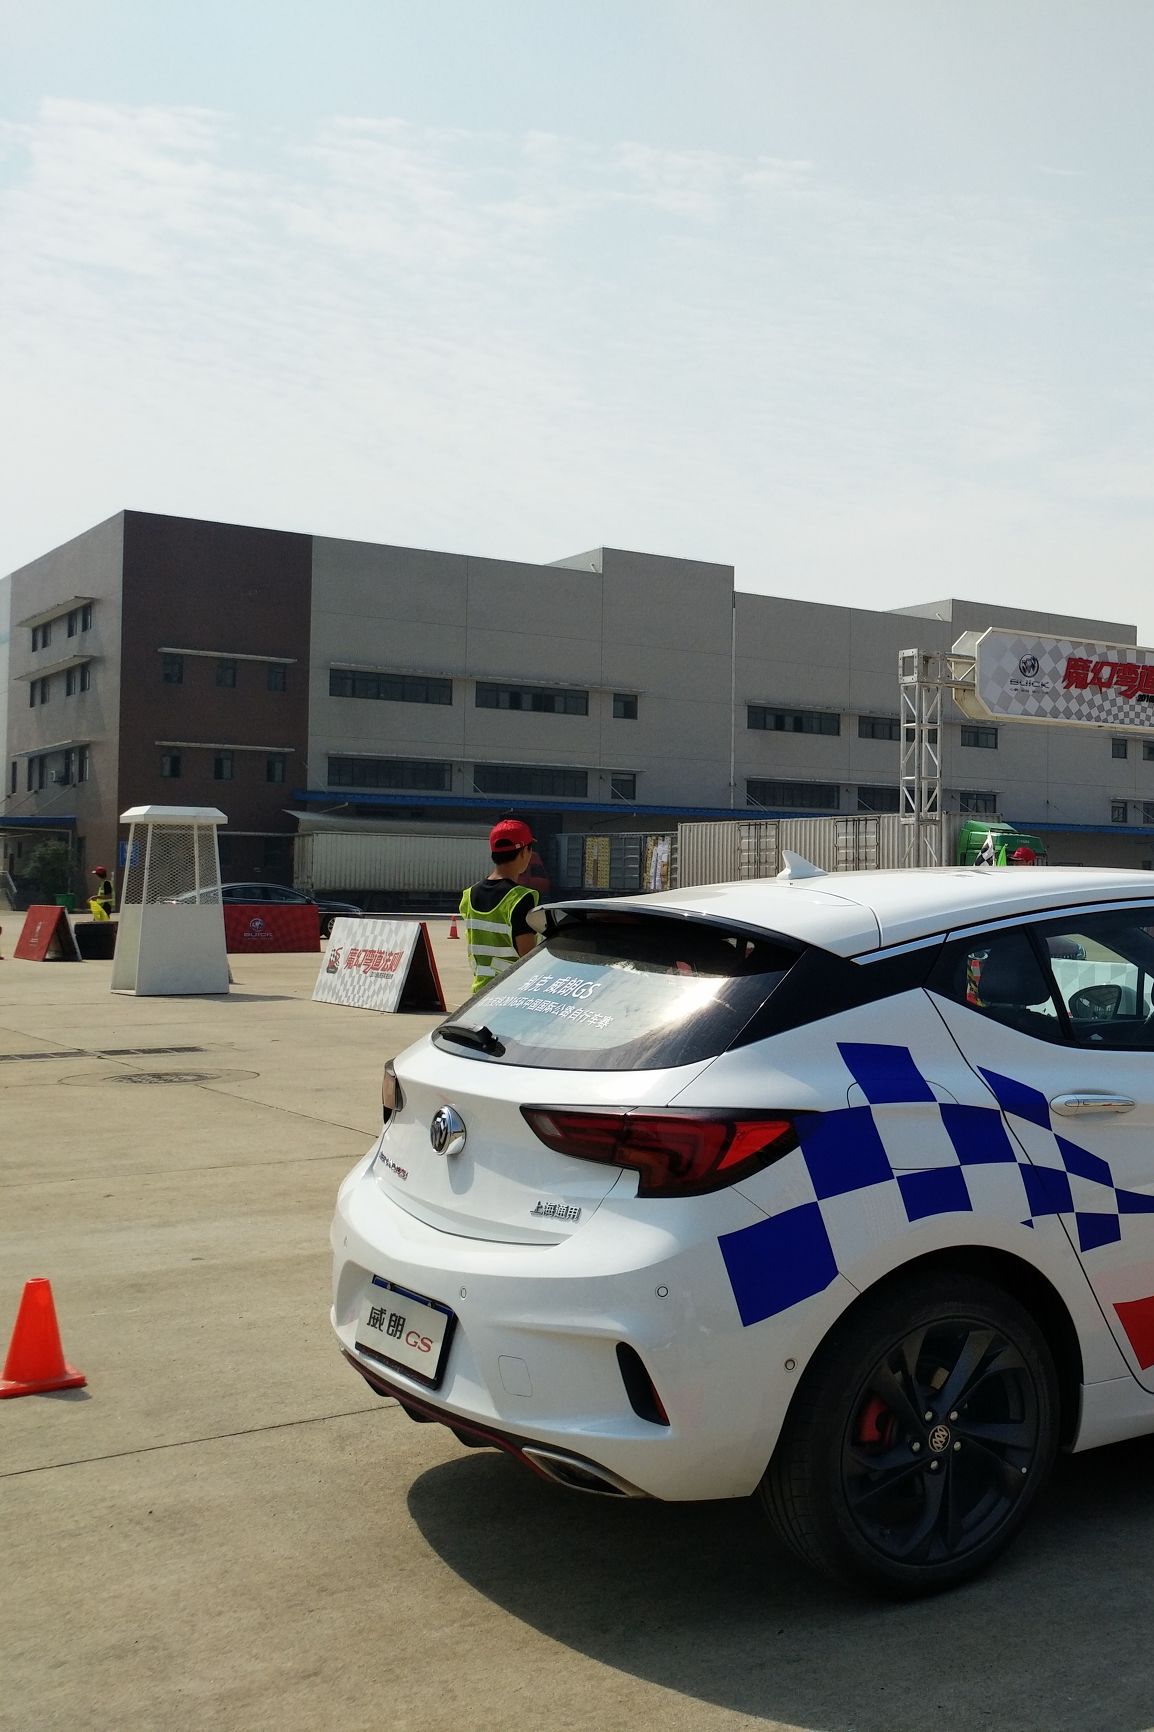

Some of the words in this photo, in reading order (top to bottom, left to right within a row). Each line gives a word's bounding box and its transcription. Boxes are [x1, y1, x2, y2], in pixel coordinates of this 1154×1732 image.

[1009, 678, 1050, 689] BUICK
[344, 947, 404, 975] 魔幻弯道法则
[543, 976, 602, 999] 威朗GS
[530, 1200, 582, 1222] 上海通用
